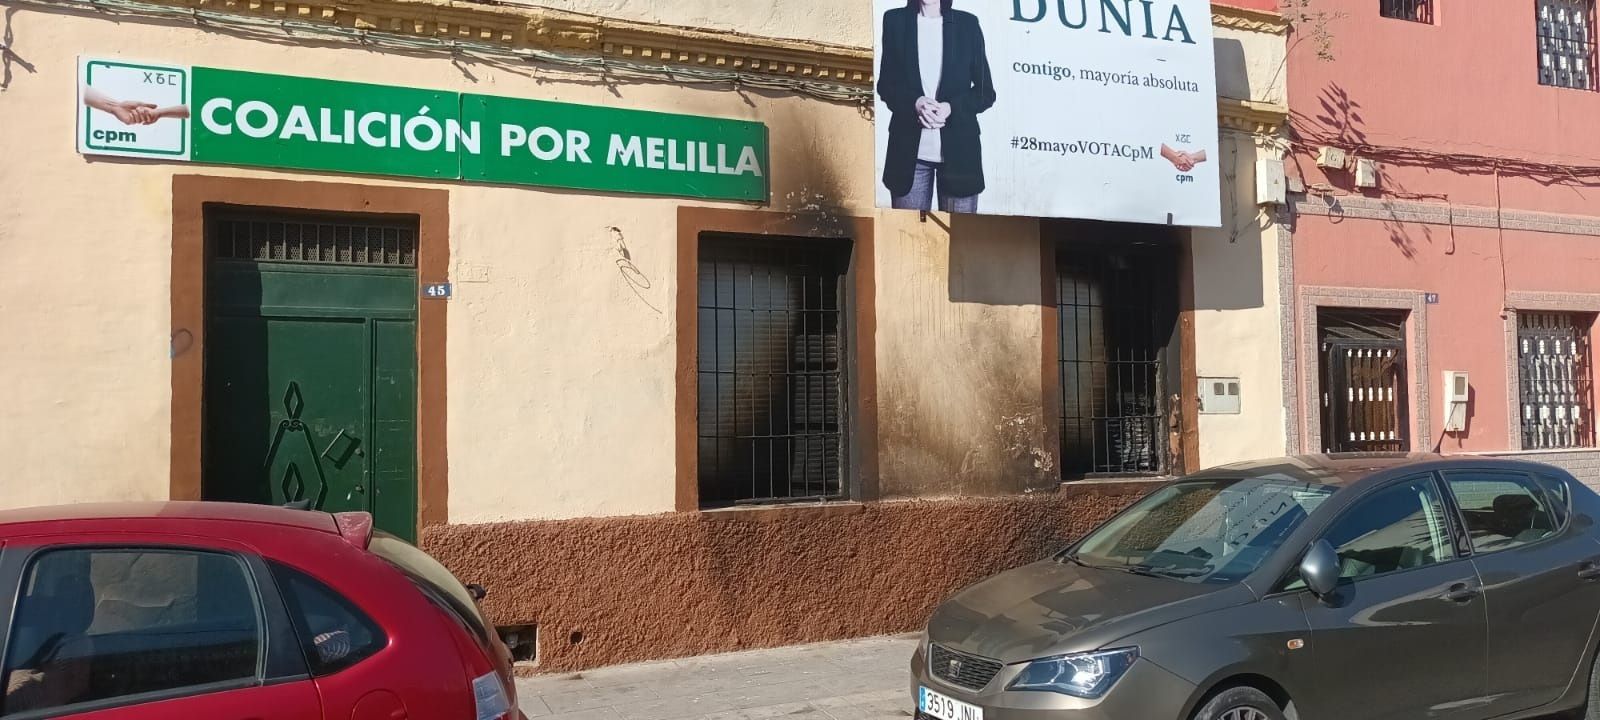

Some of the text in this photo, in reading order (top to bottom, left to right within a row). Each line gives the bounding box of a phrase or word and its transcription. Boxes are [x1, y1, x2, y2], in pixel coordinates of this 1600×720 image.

[1012, 61, 1199, 93] contigo, mayoría absoluta
[93, 129, 137, 143] cpm
[201, 97, 763, 177] COALICIÓN POR MELILLA
[1010, 136, 1154, 162] #28mayoVOTACpM
[1175, 173, 1194, 184] cpm
[428, 285, 446, 297] 45
[927, 692, 954, 719] 3519
